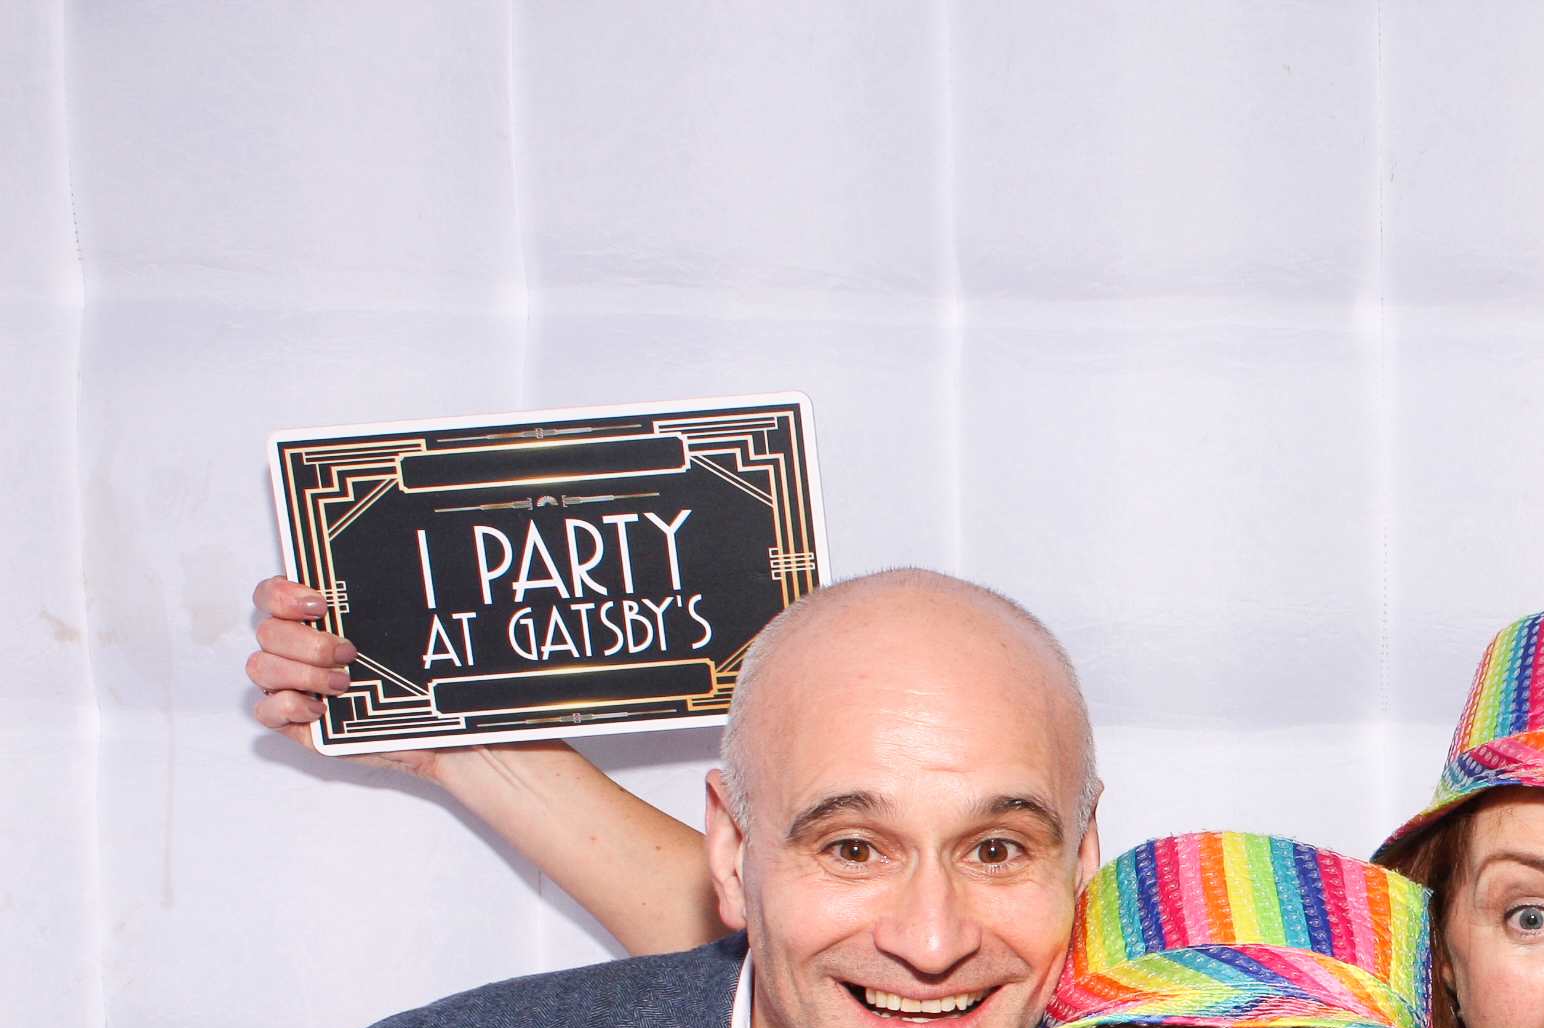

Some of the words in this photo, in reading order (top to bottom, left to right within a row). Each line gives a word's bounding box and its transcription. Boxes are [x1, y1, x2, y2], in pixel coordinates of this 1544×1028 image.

[417, 529, 437, 609] I
[473, 509, 692, 605] PARTY
[423, 612, 477, 669] AT
[508, 594, 712, 661] GATSBY'S
